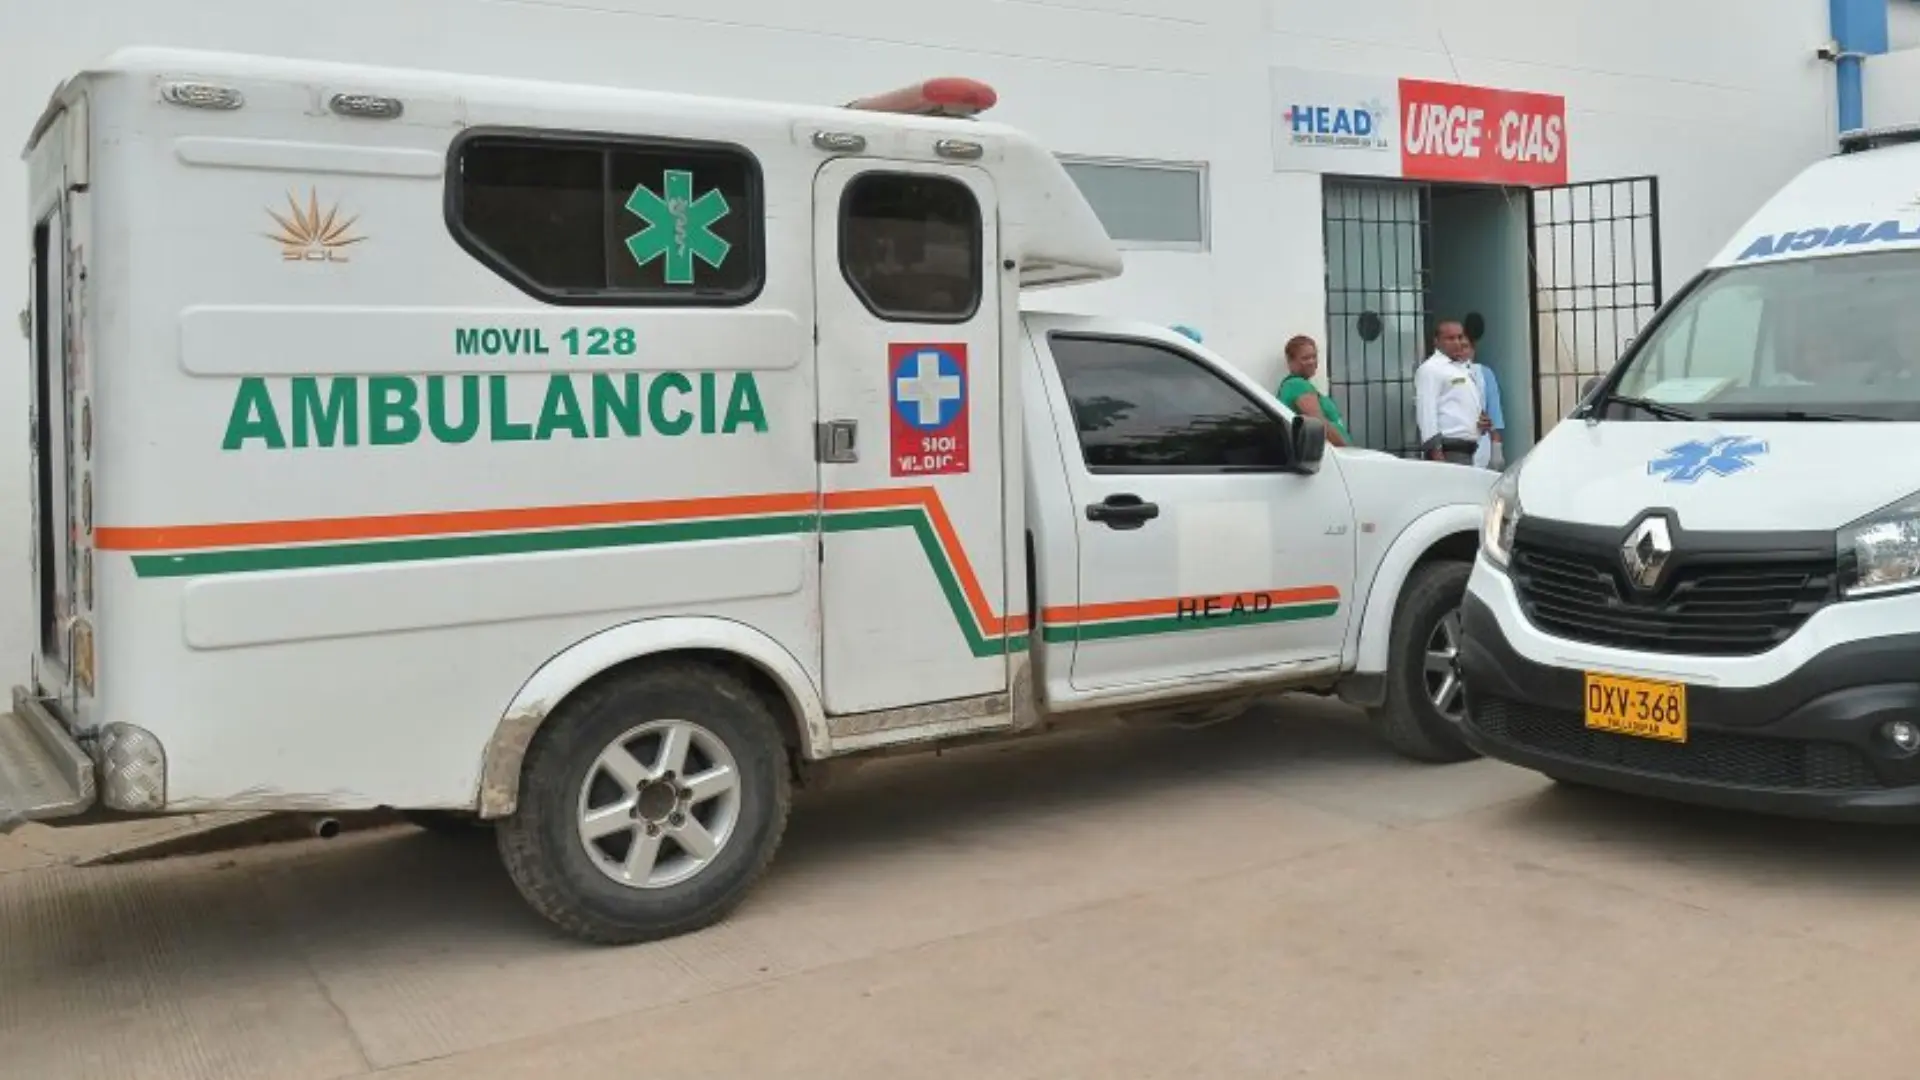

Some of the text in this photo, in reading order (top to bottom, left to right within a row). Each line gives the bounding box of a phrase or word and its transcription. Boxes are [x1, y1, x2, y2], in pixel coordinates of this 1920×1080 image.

[1292, 104, 1371, 136] HEAD
[1406, 102, 1561, 163] URGECIAS
[455, 327, 637, 355] MOVIL 128
[222, 371, 769, 450] AMBULANCIA
